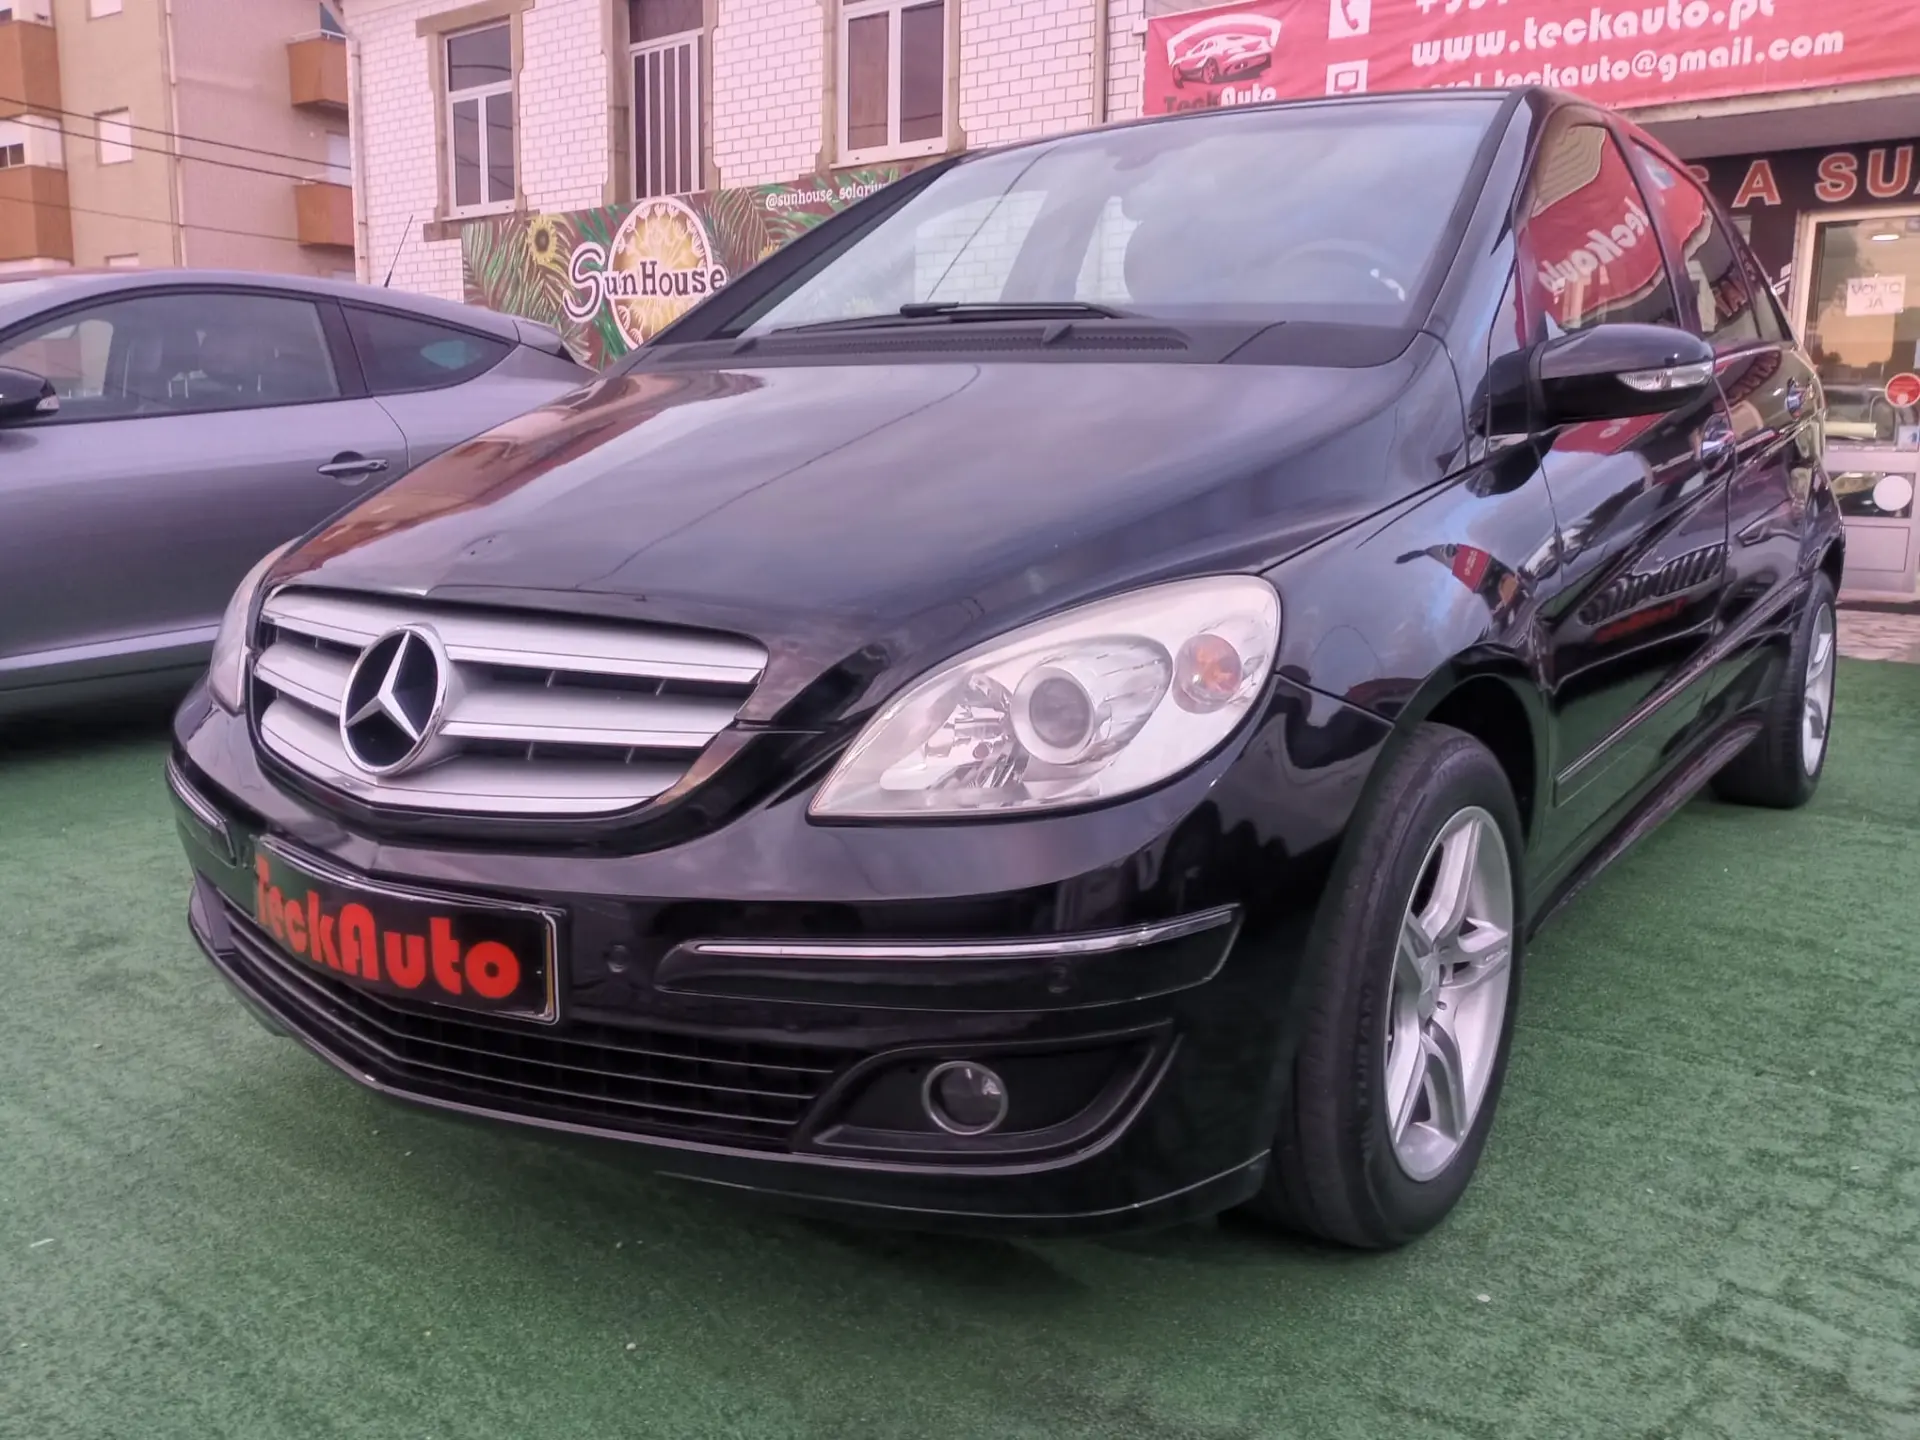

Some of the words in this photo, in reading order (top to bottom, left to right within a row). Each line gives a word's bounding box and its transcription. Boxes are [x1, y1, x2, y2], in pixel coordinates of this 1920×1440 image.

[1731, 159, 1782, 208] A
[1814, 146, 1920, 203] SU
[254, 853, 521, 999] TeckAuto
